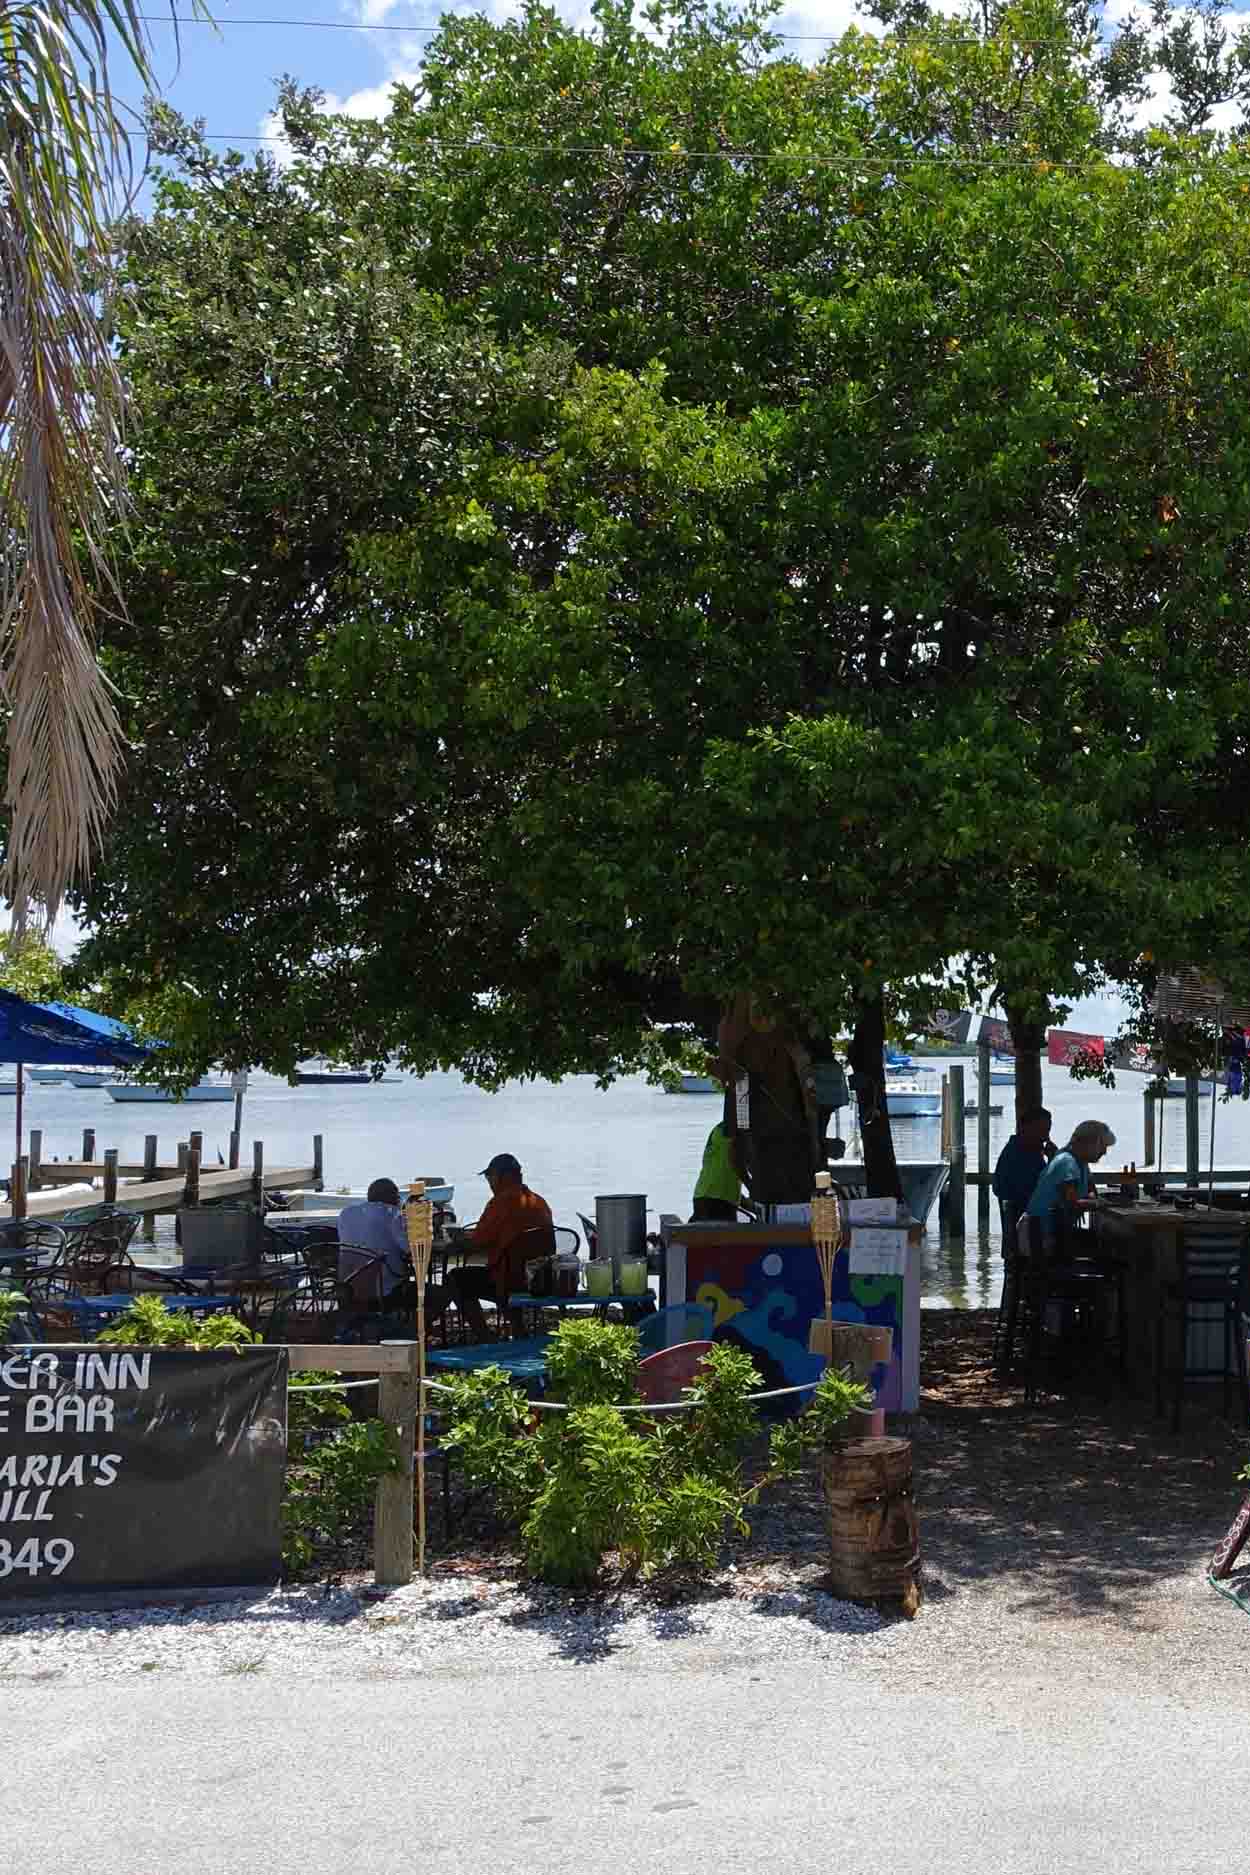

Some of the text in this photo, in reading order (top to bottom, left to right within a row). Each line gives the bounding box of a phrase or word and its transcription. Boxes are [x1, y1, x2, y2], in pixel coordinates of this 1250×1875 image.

[0, 1352, 152, 1390] ER INN
[25, 1394, 115, 1433] BAR
